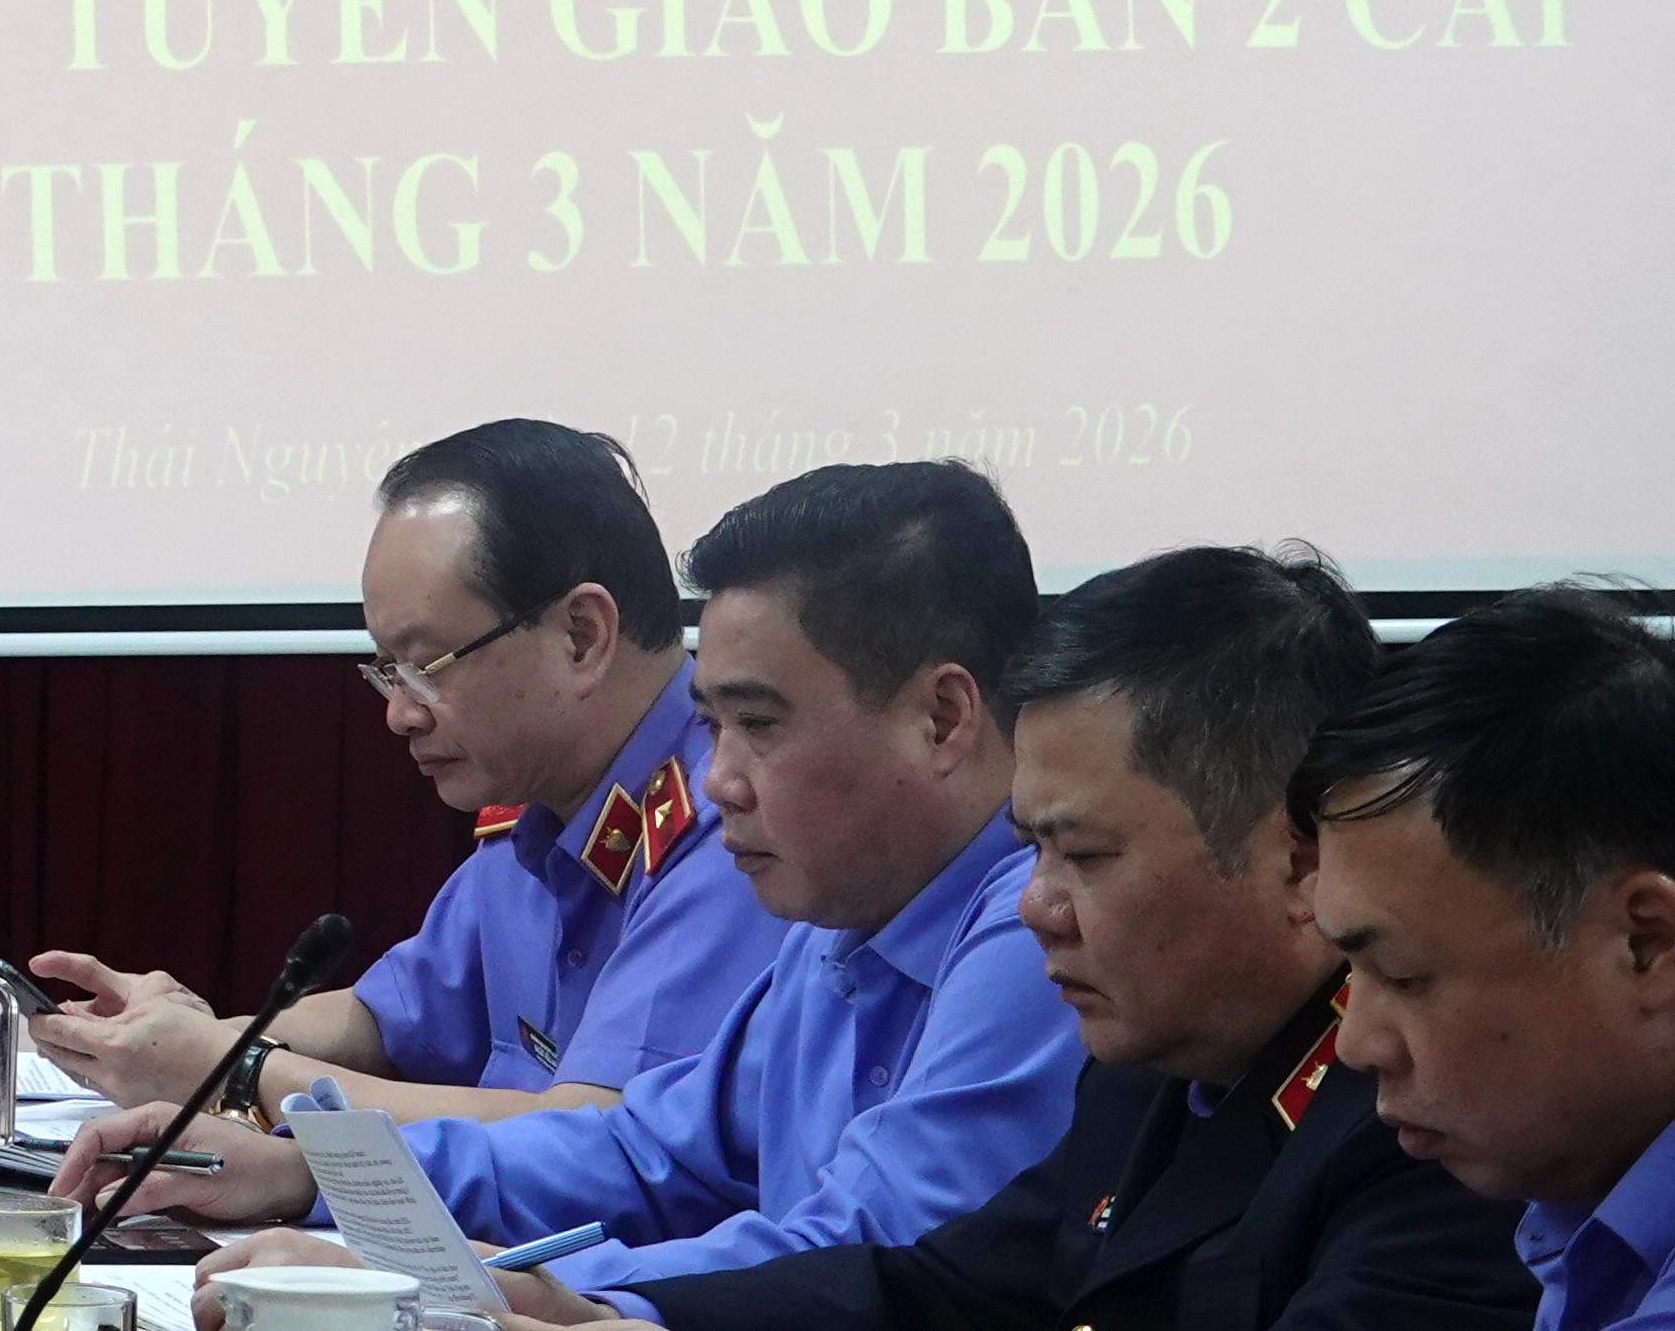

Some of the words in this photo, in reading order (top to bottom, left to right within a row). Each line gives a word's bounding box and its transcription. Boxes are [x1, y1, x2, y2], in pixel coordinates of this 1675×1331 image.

[2, 118, 487, 283] THÁNG
[525, 149, 587, 273] 3
[633, 115, 933, 269] NĂM
[976, 139, 1235, 264] 2026
[76, 423, 195, 489] Thái
[1058, 403, 1195, 467] 2026
